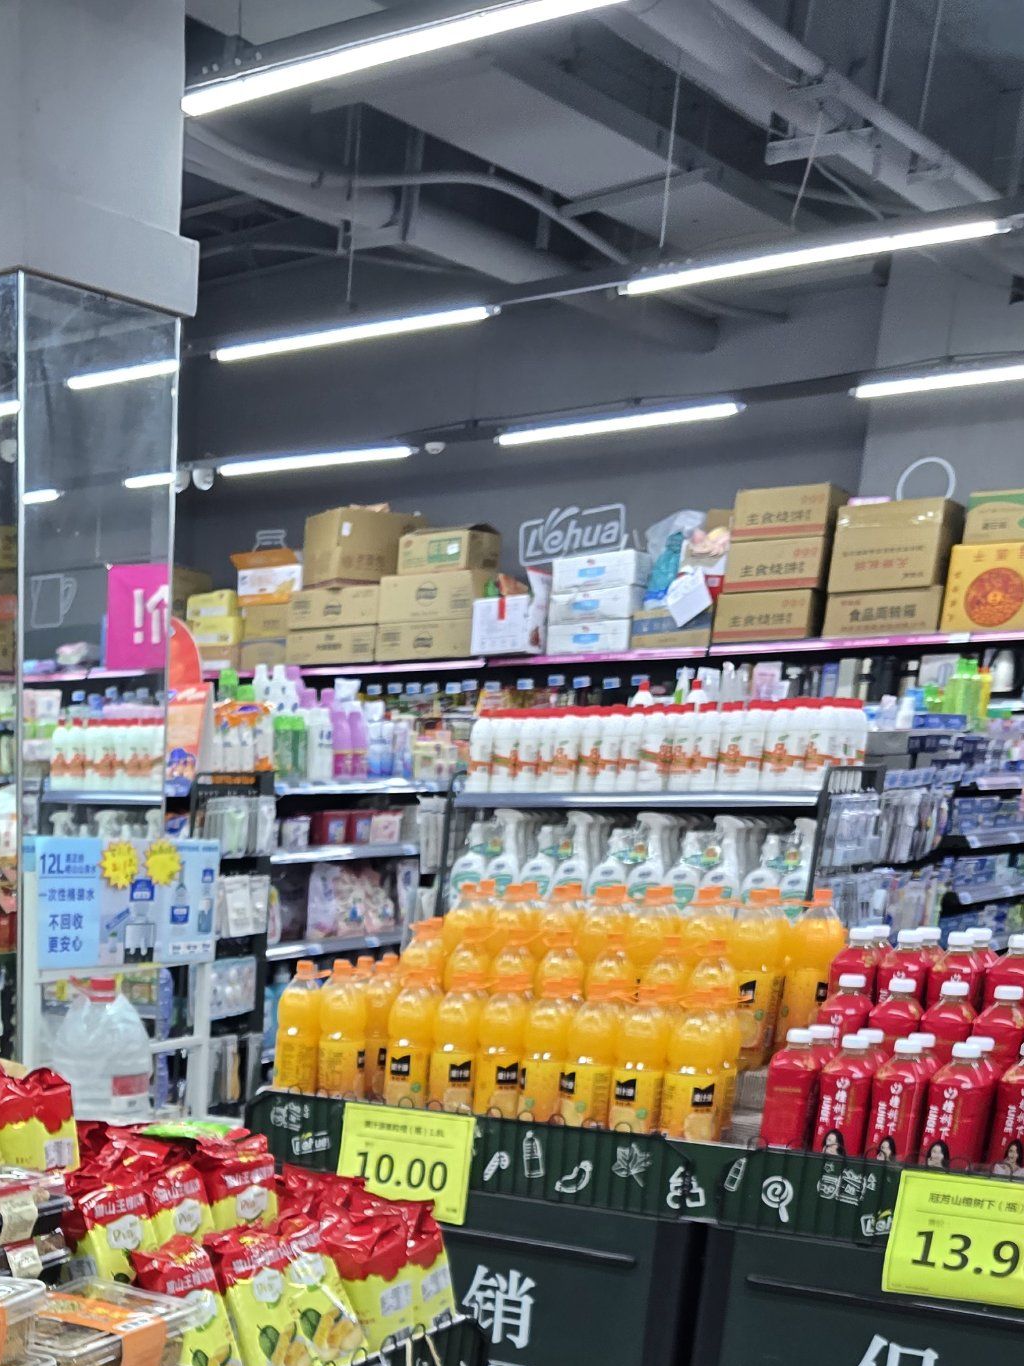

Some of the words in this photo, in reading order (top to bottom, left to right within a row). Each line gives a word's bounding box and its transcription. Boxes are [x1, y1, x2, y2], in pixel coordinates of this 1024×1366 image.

[526, 510, 621, 557] Lehua
[40, 853, 64, 875] 12L
[48, 913, 84, 931] 不回收
[48, 936, 83, 954] 更安心
[355, 1151, 448, 1191] 10.00
[462, 1264, 536, 1349] 销
